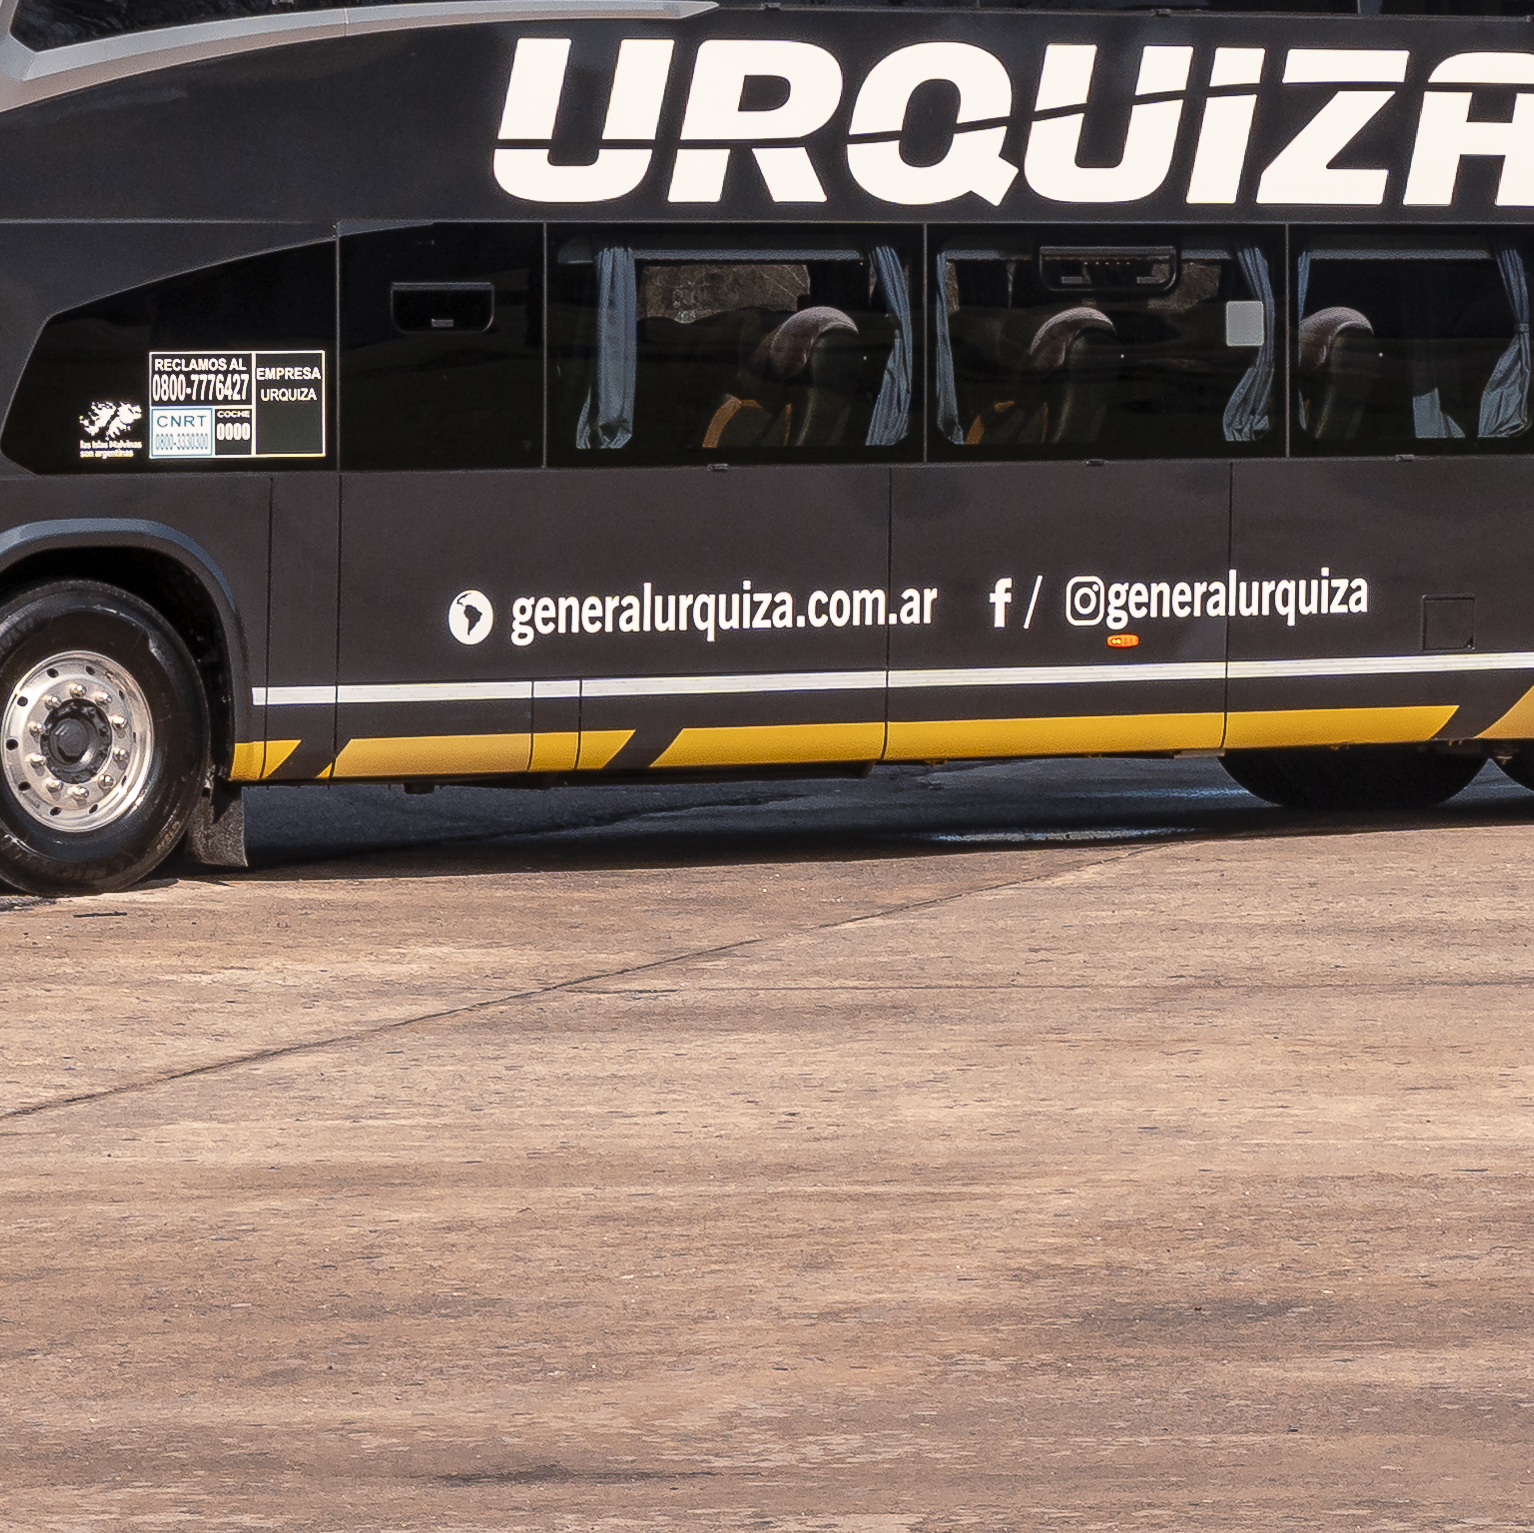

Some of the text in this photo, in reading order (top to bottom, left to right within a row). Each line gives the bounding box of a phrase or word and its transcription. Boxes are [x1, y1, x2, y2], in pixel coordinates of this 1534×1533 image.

[154, 358, 247, 371] RECLAMOS AL
[256, 366, 322, 381] EMPRESA
[152, 373, 250, 402] 0800-7776427
[260, 387, 318, 402] URQUIZA
[156, 415, 207, 428] CNRT
[216, 410, 250, 419] COCHE
[510, 579, 938, 646] generalurquiza.com.ar
